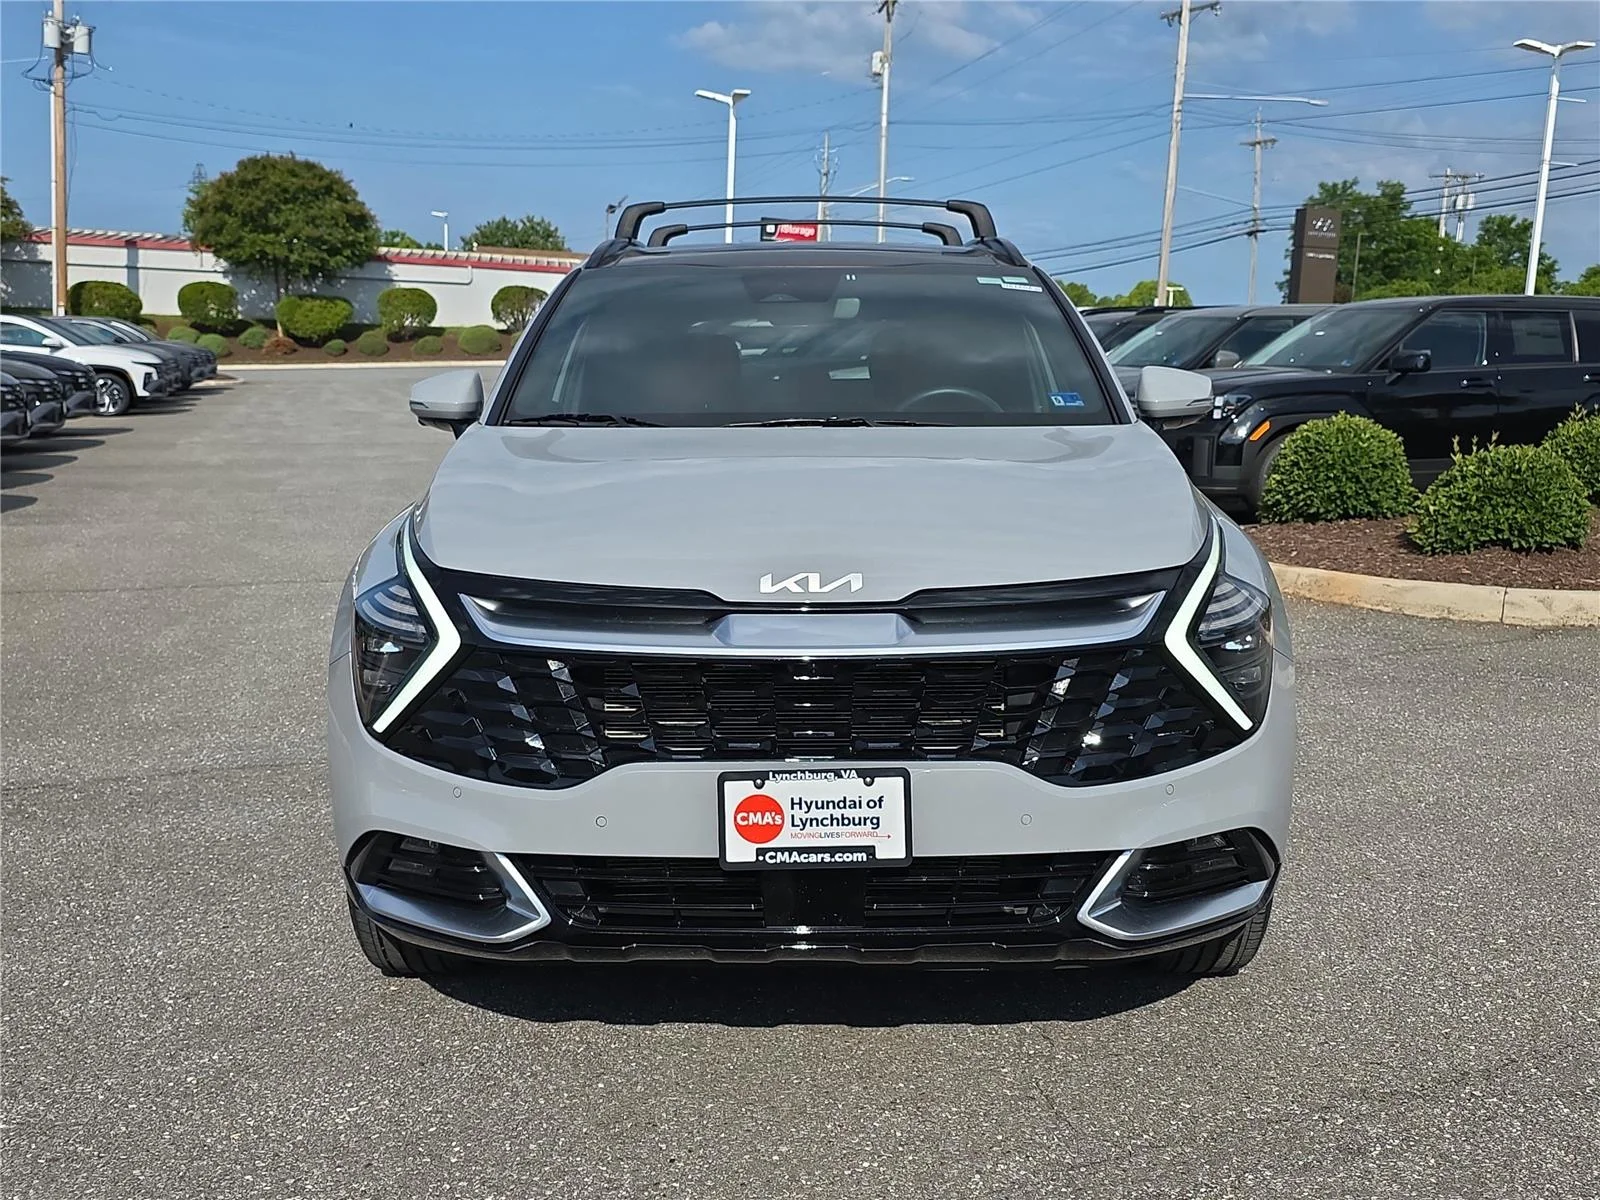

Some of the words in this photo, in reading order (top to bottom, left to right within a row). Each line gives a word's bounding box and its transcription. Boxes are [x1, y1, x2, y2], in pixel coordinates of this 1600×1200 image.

[760, 573, 863, 594] KIA
[768, 770, 839, 784] Lynchburg,
[841, 769, 859, 780] VA
[790, 797, 862, 814] Hyundai
[866, 795, 885, 810] of
[736, 811, 783, 826] CMA's
[790, 813, 881, 830] Lynchburg
[764, 851, 868, 864] CMAcars.com
